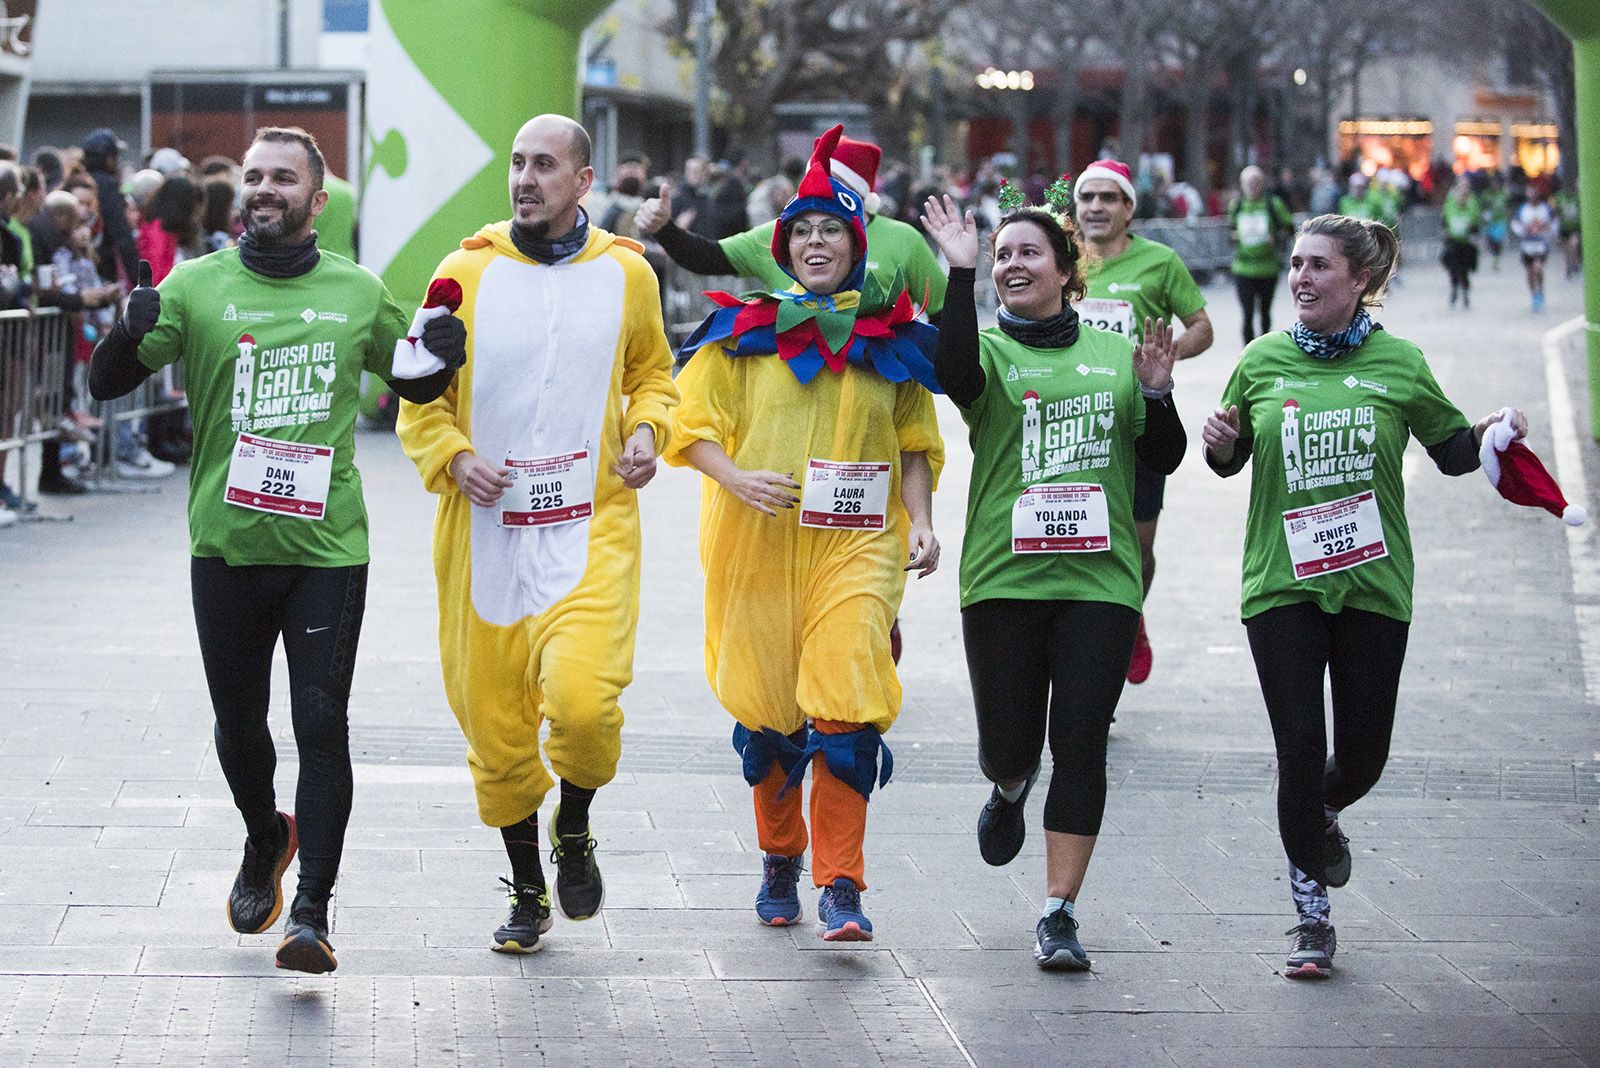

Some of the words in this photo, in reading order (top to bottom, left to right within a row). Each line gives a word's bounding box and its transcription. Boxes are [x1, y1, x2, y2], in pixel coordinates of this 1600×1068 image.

[260, 345, 308, 369] CURSA
[312, 342, 336, 361] DEL
[257, 366, 314, 399] GALL
[254, 397, 290, 417] SANT
[291, 392, 333, 412] CUGAT
[1046, 395, 1091, 421] CURSA
[1094, 392, 1115, 411] DEL
[232, 421, 240, 432] 31
[241, 420, 252, 431] DE
[253, 414, 297, 429] DESEMBRE
[298, 413, 310, 425] DE
[1304, 408, 1351, 432] CURSA
[1354, 406, 1376, 426] DEL
[1045, 415, 1097, 450] GALL
[1044, 445, 1078, 468] SANT
[1078, 439, 1112, 459] CUGAT
[1304, 429, 1359, 460] GALL
[266, 466, 295, 482] DANI
[1022, 471, 1031, 483] 31
[1032, 469, 1042, 480] DE
[1081, 458, 1090, 470] DE
[1090, 457, 1110, 468] 2023
[1304, 458, 1337, 478] SANT
[1338, 453, 1376, 472] CUGAT
[260, 481, 296, 497] 222
[529, 481, 562, 496] JULIO
[833, 487, 865, 499] LAURA
[1287, 482, 1297, 494] 31
[1305, 474, 1345, 491] DESEMBRE
[530, 495, 564, 510] 225
[833, 500, 862, 514] 226
[1035, 510, 1088, 522] YOLANDA
[1044, 523, 1079, 536] 865
[1312, 522, 1358, 544] JENIFER
[1322, 537, 1356, 556] 322
